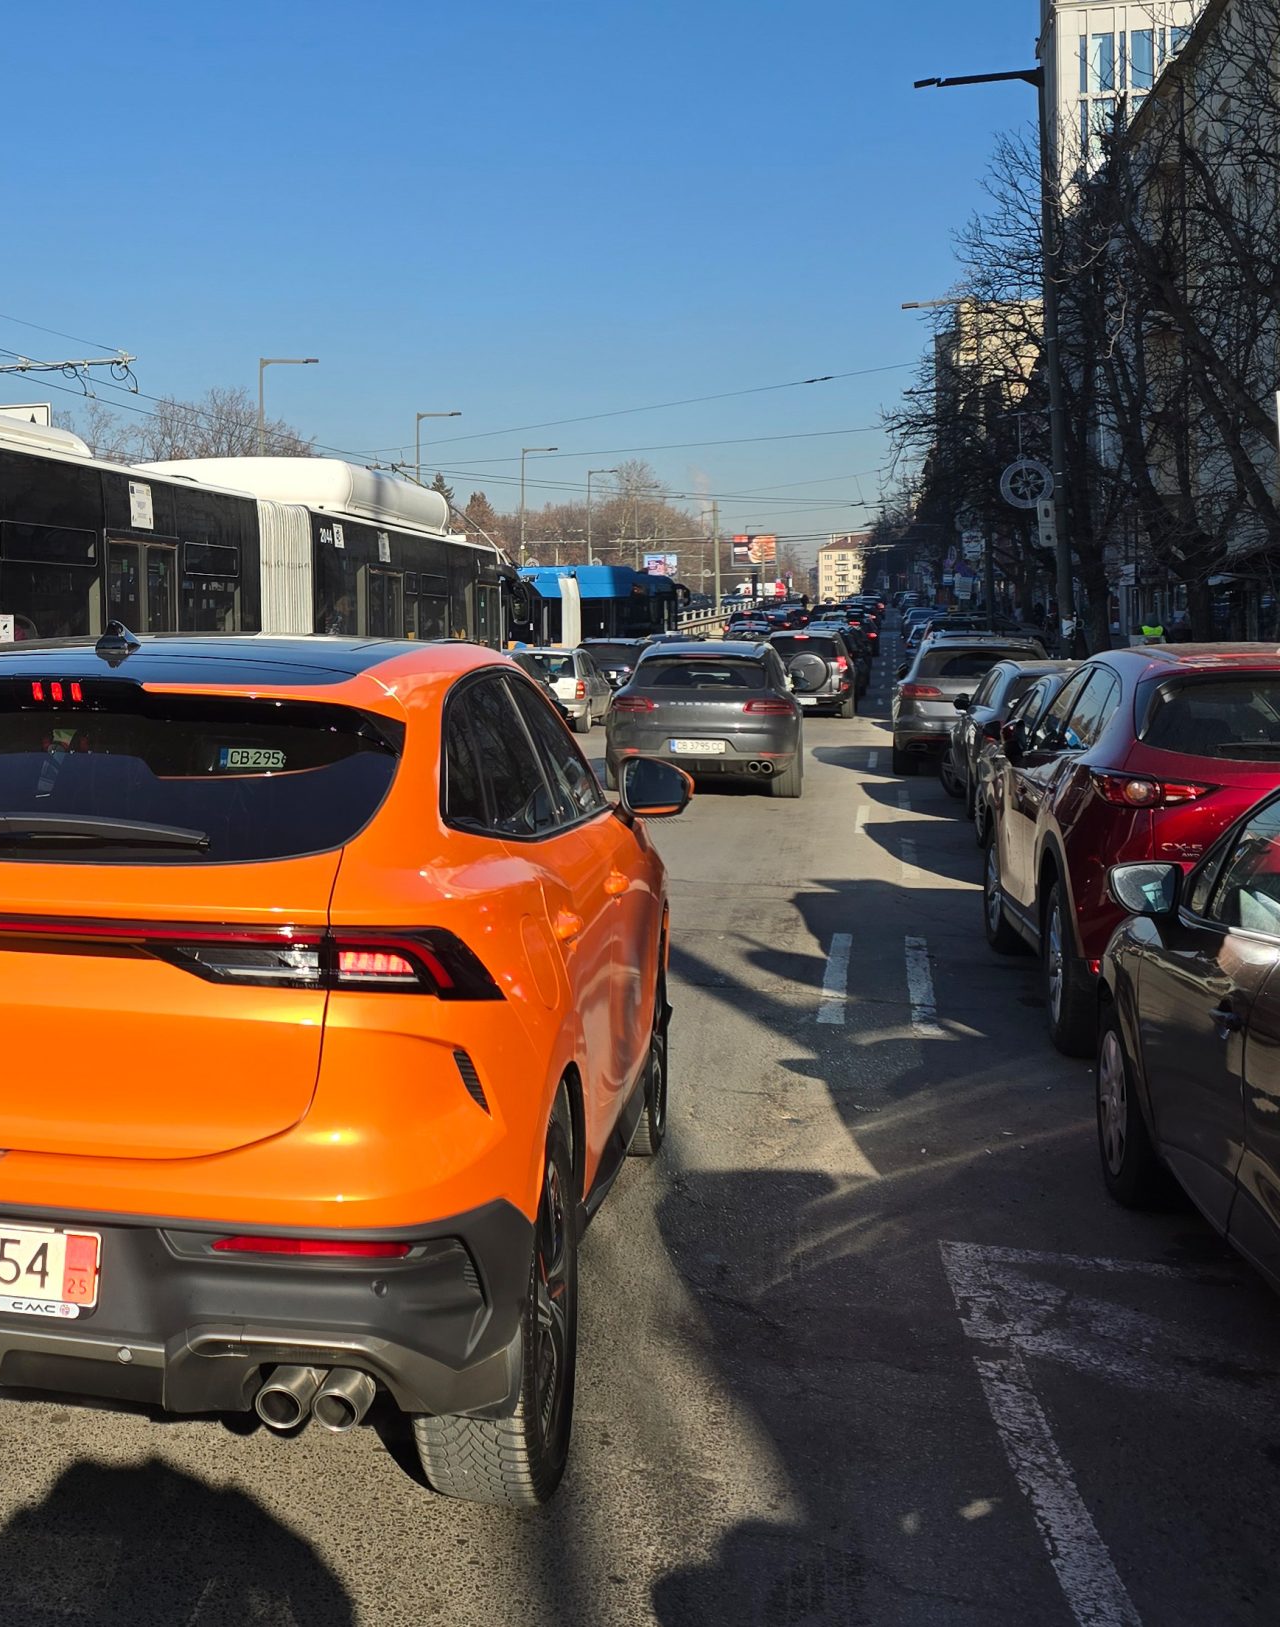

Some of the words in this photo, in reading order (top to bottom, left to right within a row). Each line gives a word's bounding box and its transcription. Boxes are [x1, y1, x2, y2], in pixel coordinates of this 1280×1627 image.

[230, 750, 250, 765] CB
[1161, 842, 1203, 852] CX-5
[67, 1278, 87, 1295] 25
[12, 1301, 56, 1313] CMC
